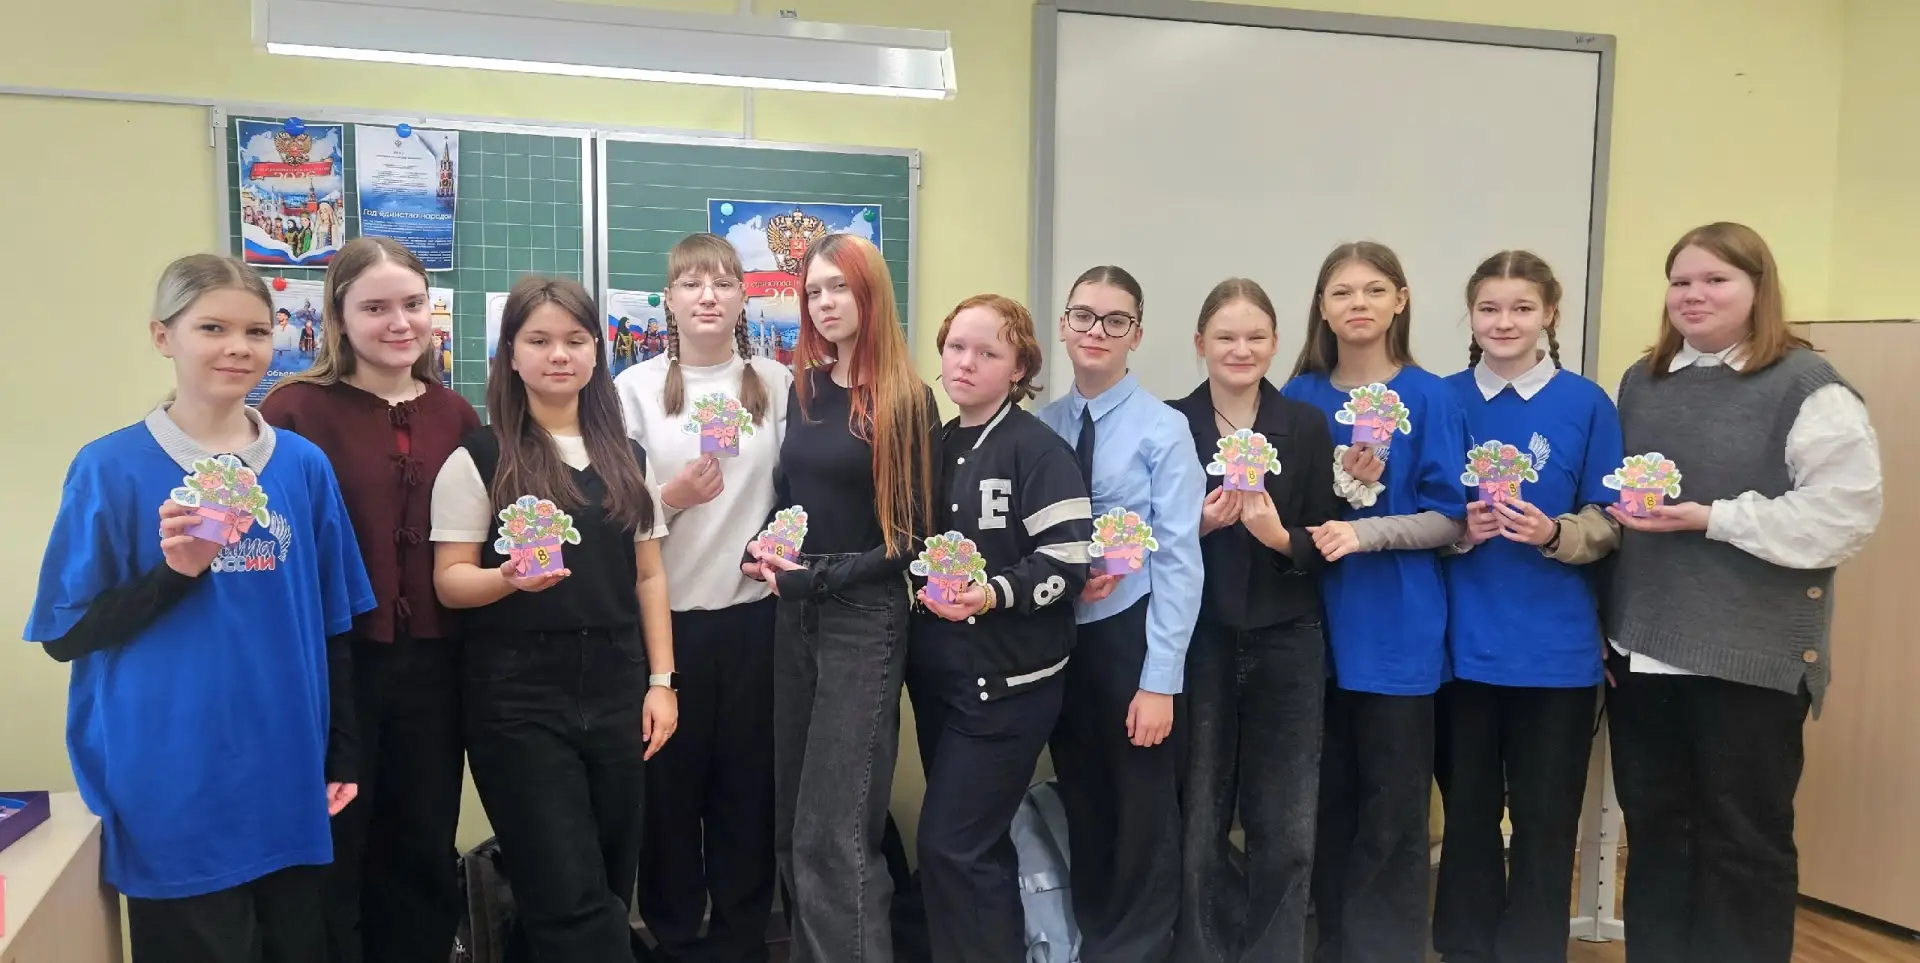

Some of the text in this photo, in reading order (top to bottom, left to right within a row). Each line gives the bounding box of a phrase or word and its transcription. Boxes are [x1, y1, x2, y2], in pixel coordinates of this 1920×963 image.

[363, 208, 378, 217] Год
[765, 287, 798, 307] 20
[1509, 483, 1517, 493] 8
[978, 479, 1011, 529] E
[1647, 496, 1654, 506] 8
[538, 549, 547, 561] 8
[776, 545, 783, 555] 8
[1033, 575, 1065, 605] 8
